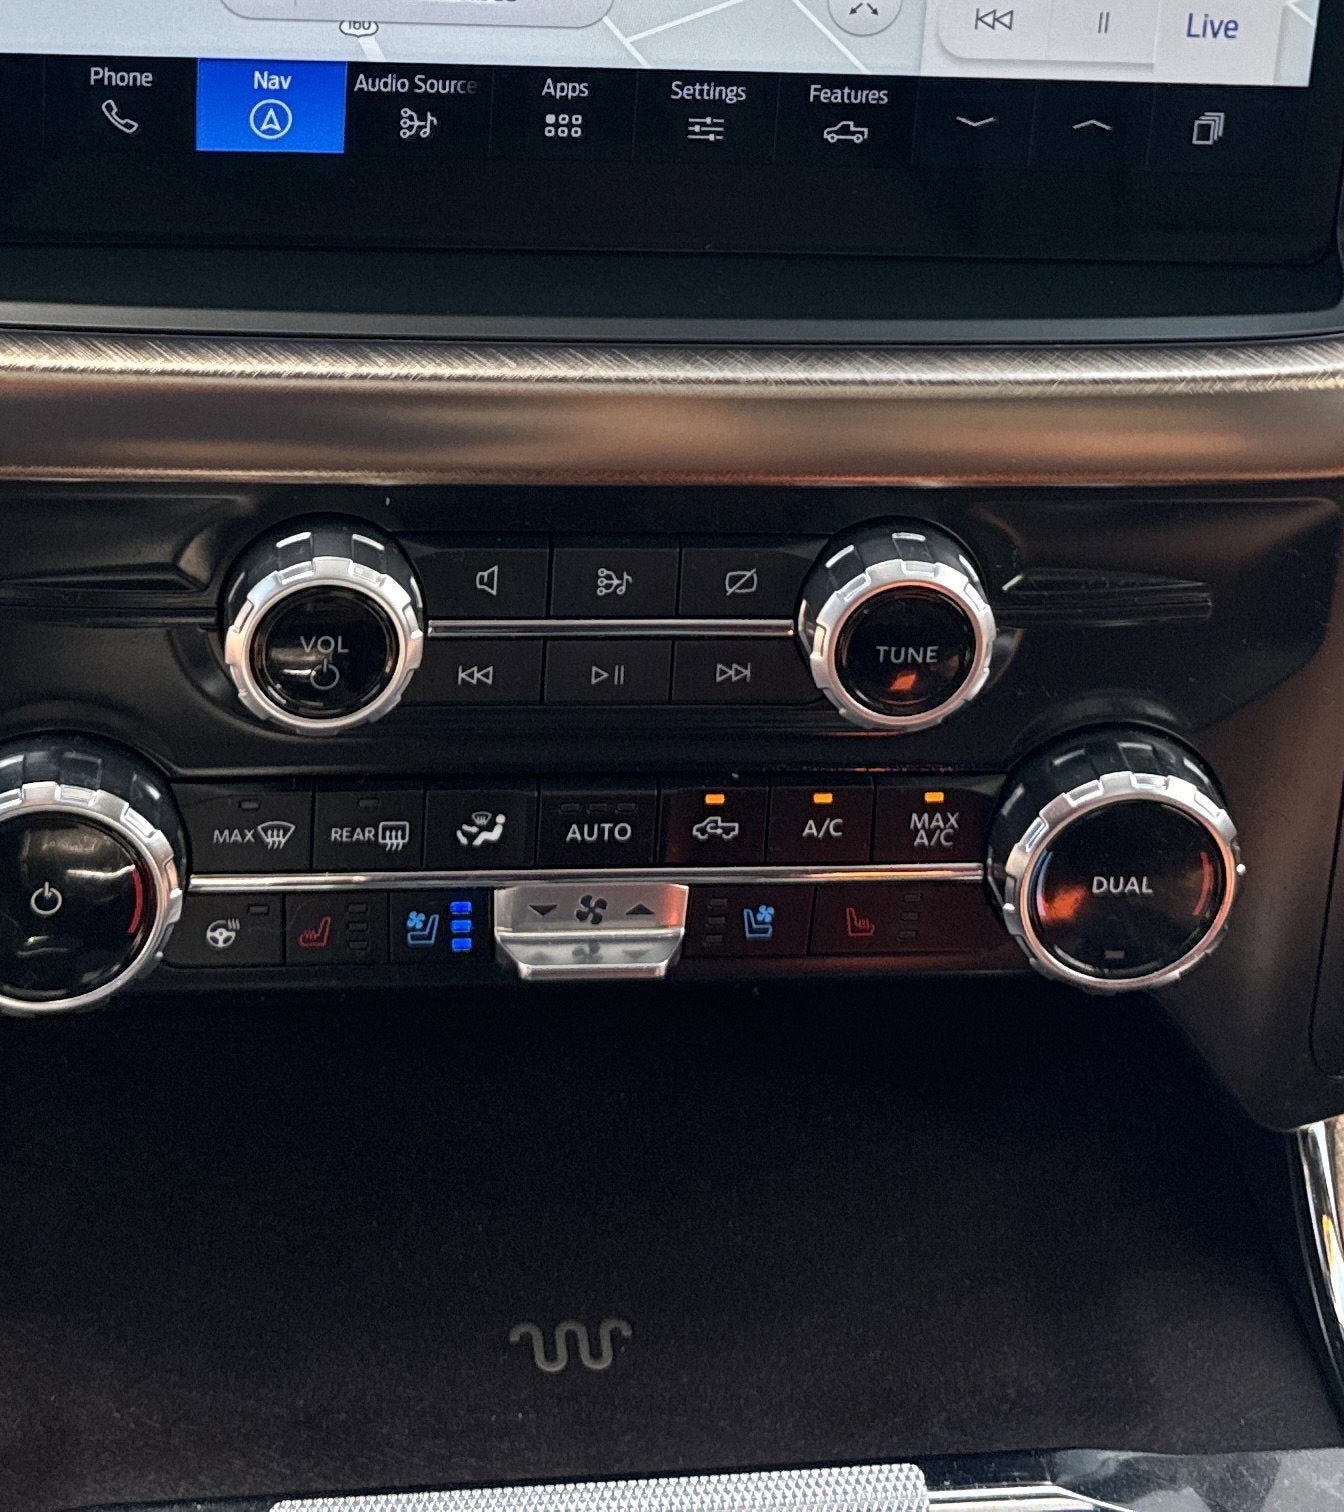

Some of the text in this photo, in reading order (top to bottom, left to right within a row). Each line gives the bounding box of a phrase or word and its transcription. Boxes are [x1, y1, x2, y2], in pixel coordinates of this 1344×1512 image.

[1186, 12, 1240, 40] Live
[89, 66, 154, 88] Phone
[252, 70, 292, 91] Nav
[353, 73, 410, 93] Audio
[542, 77, 589, 100] Apps
[670, 80, 747, 104] Settings
[809, 84, 889, 105] Features
[300, 635, 350, 656] VOL
[875, 644, 940, 665] TUNE
[802, 817, 844, 839] A/C
[909, 812, 960, 830] MAX
[212, 827, 255, 845] MAX
[331, 825, 376, 843] REAR
[566, 822, 633, 843] AUTO
[913, 828, 955, 848] A/C
[1091, 875, 1154, 896] DUAL
